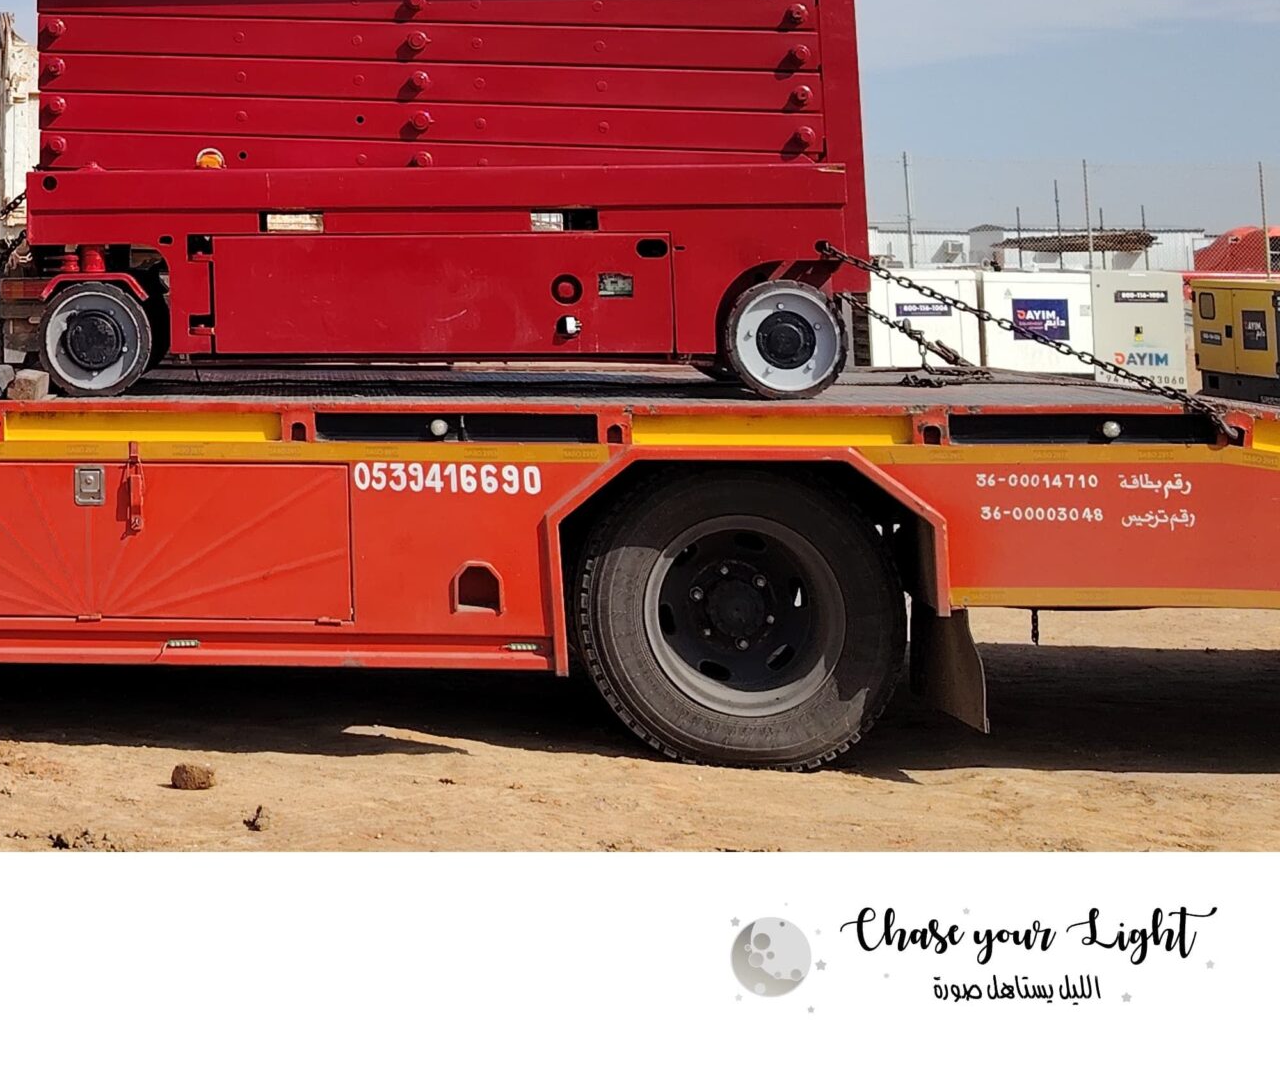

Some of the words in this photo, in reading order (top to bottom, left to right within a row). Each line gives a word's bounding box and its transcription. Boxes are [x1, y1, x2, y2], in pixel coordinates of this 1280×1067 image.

[1114, 352, 1169, 366] DAYIM
[354, 462, 542, 495] 0539416690
[976, 474, 1099, 488] 36-00014710
[1118, 473, 1162, 493] بطاقة
[1164, 473, 1192, 499] رقم
[980, 506, 1104, 522] 36-00003048
[1170, 509, 1196, 531] رقم
